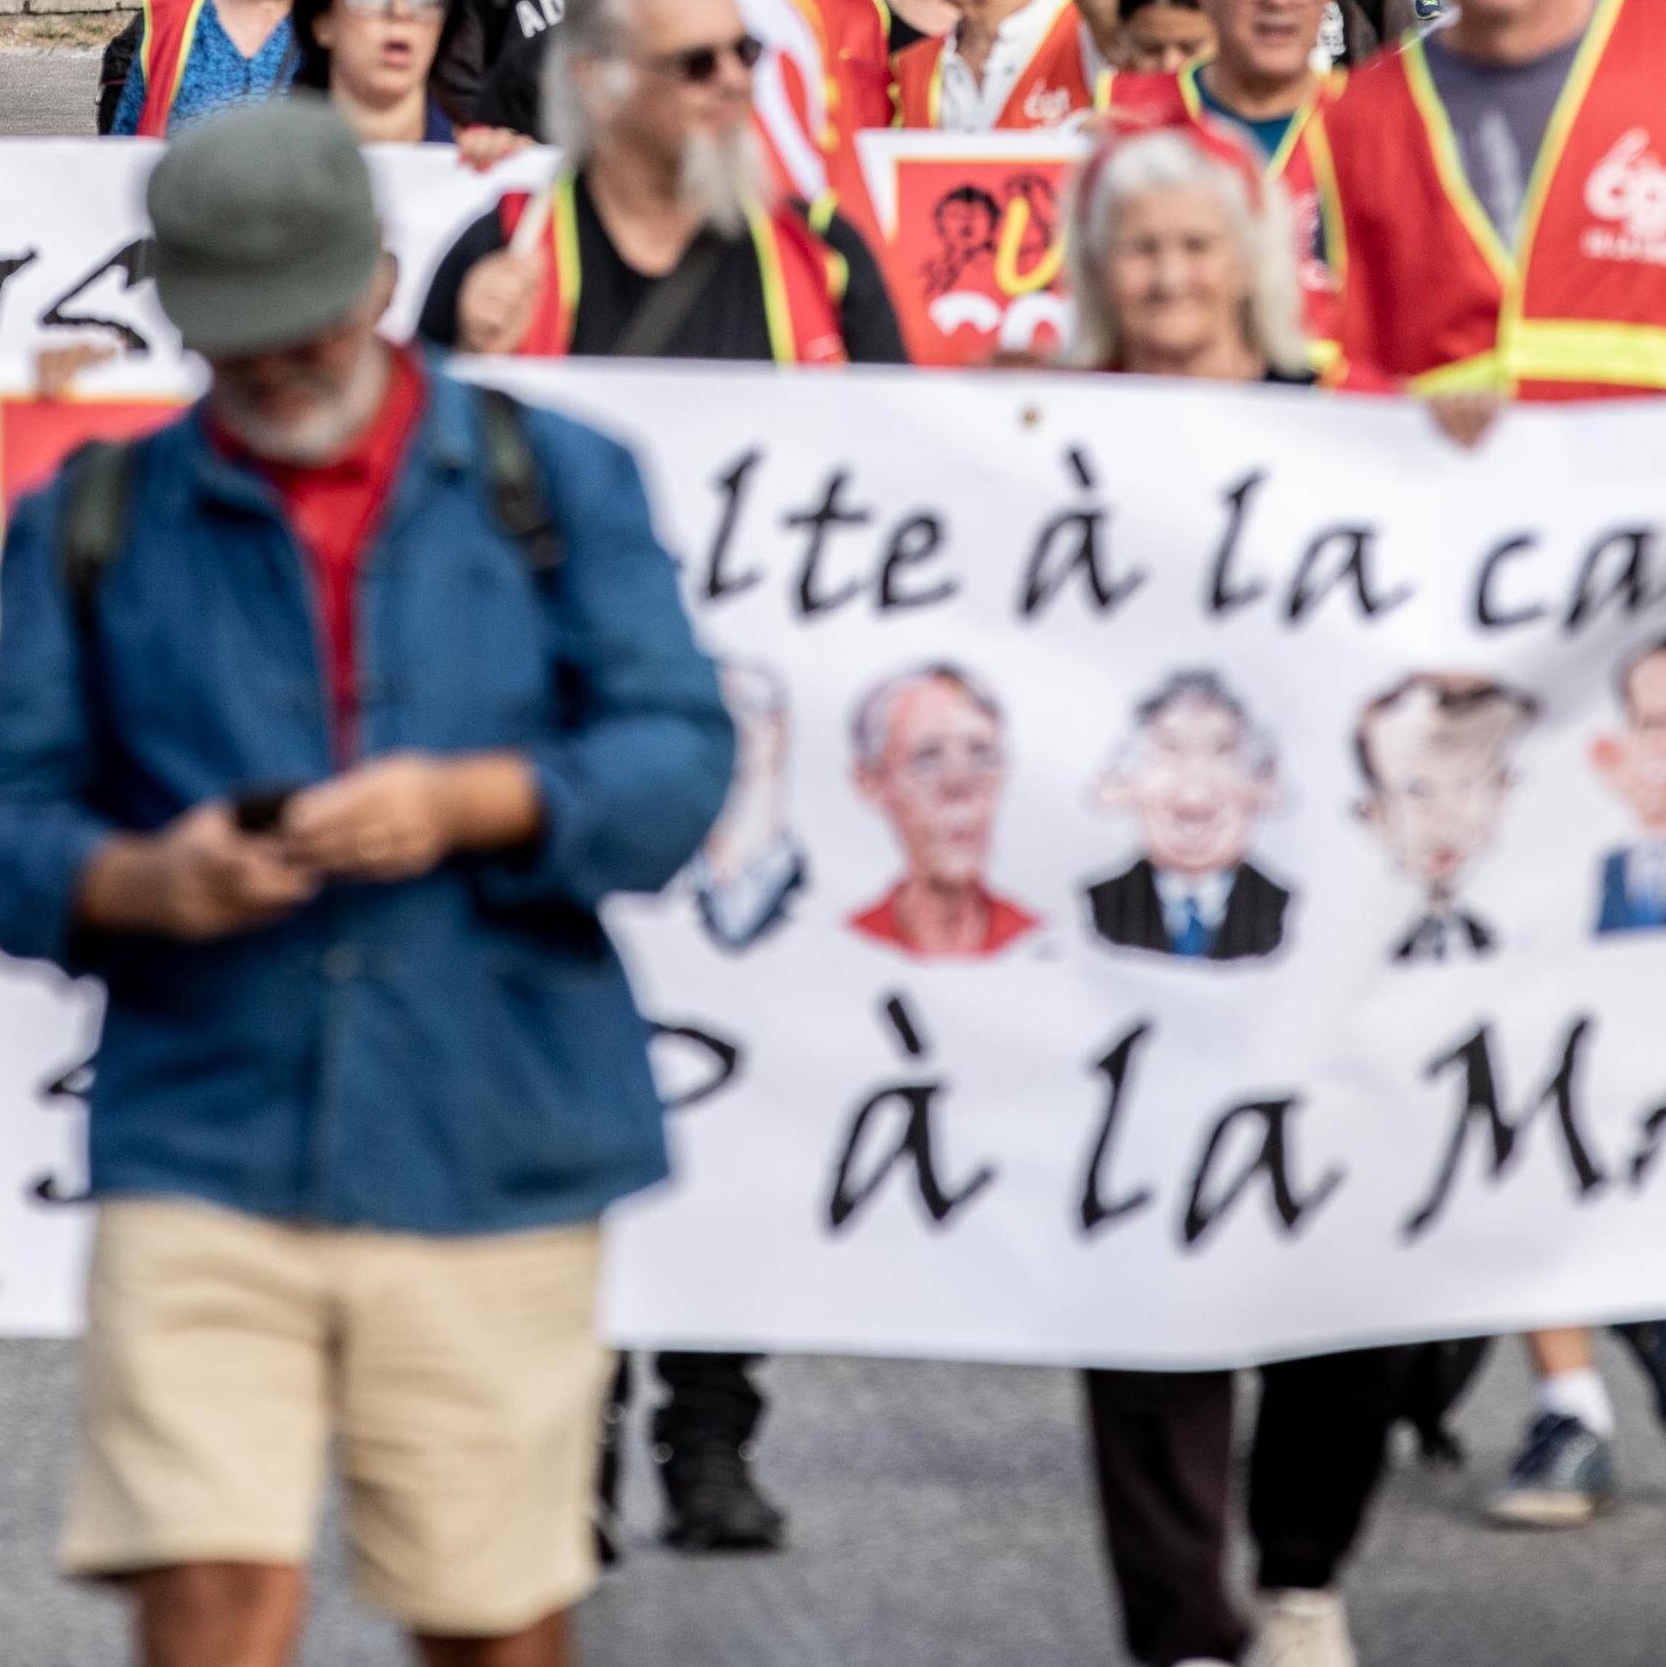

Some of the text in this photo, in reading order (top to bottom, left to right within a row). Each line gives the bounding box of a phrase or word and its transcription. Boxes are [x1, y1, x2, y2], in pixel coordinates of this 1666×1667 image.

[1016, 444, 1147, 621] à
[1203, 468, 1412, 623] la
[830, 994, 995, 1229] à
[1081, 1018, 1343, 1246] la
